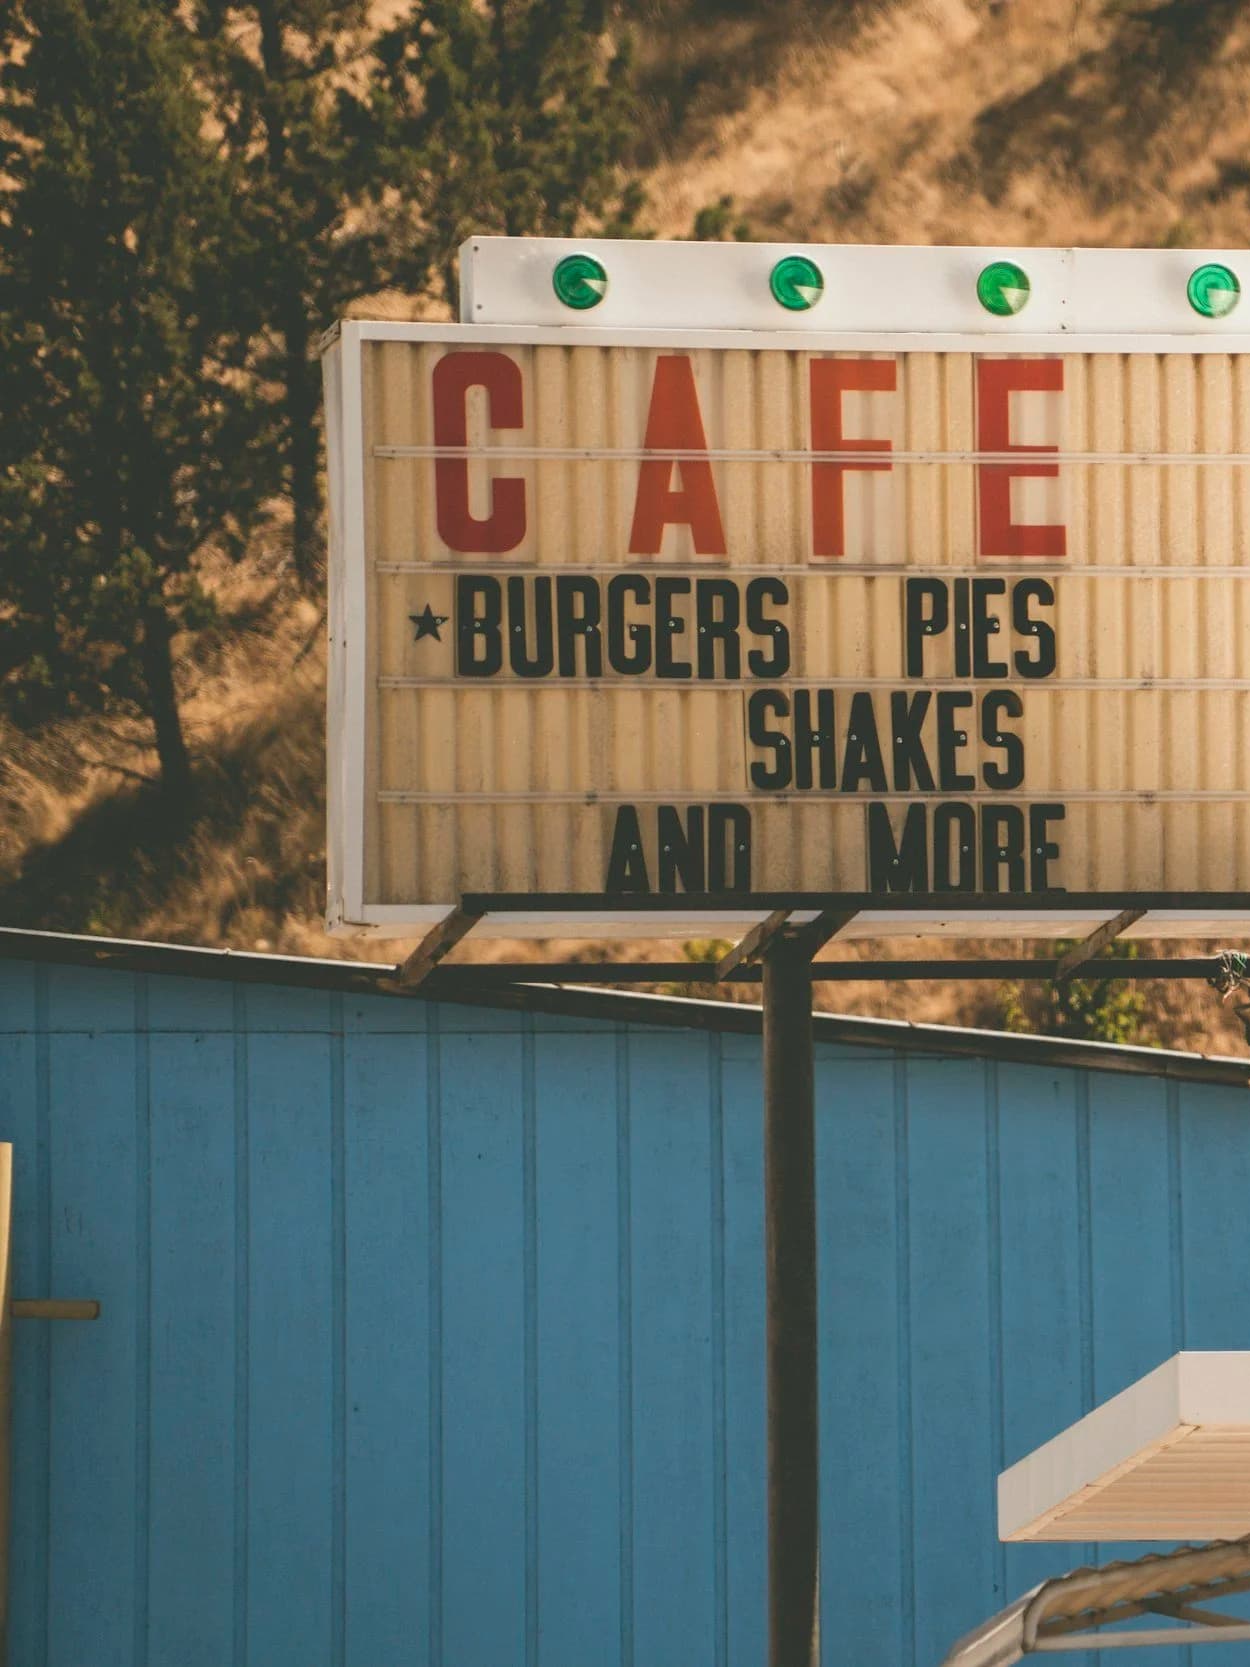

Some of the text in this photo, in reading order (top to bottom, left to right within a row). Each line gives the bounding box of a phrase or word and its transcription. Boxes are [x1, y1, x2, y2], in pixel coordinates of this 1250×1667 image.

[432, 351, 1067, 557] CAFE
[456, 574, 1056, 679] BURGERS PIES
[748, 688, 1025, 792] SHAKES
[605, 802, 1066, 893] AND MORE
